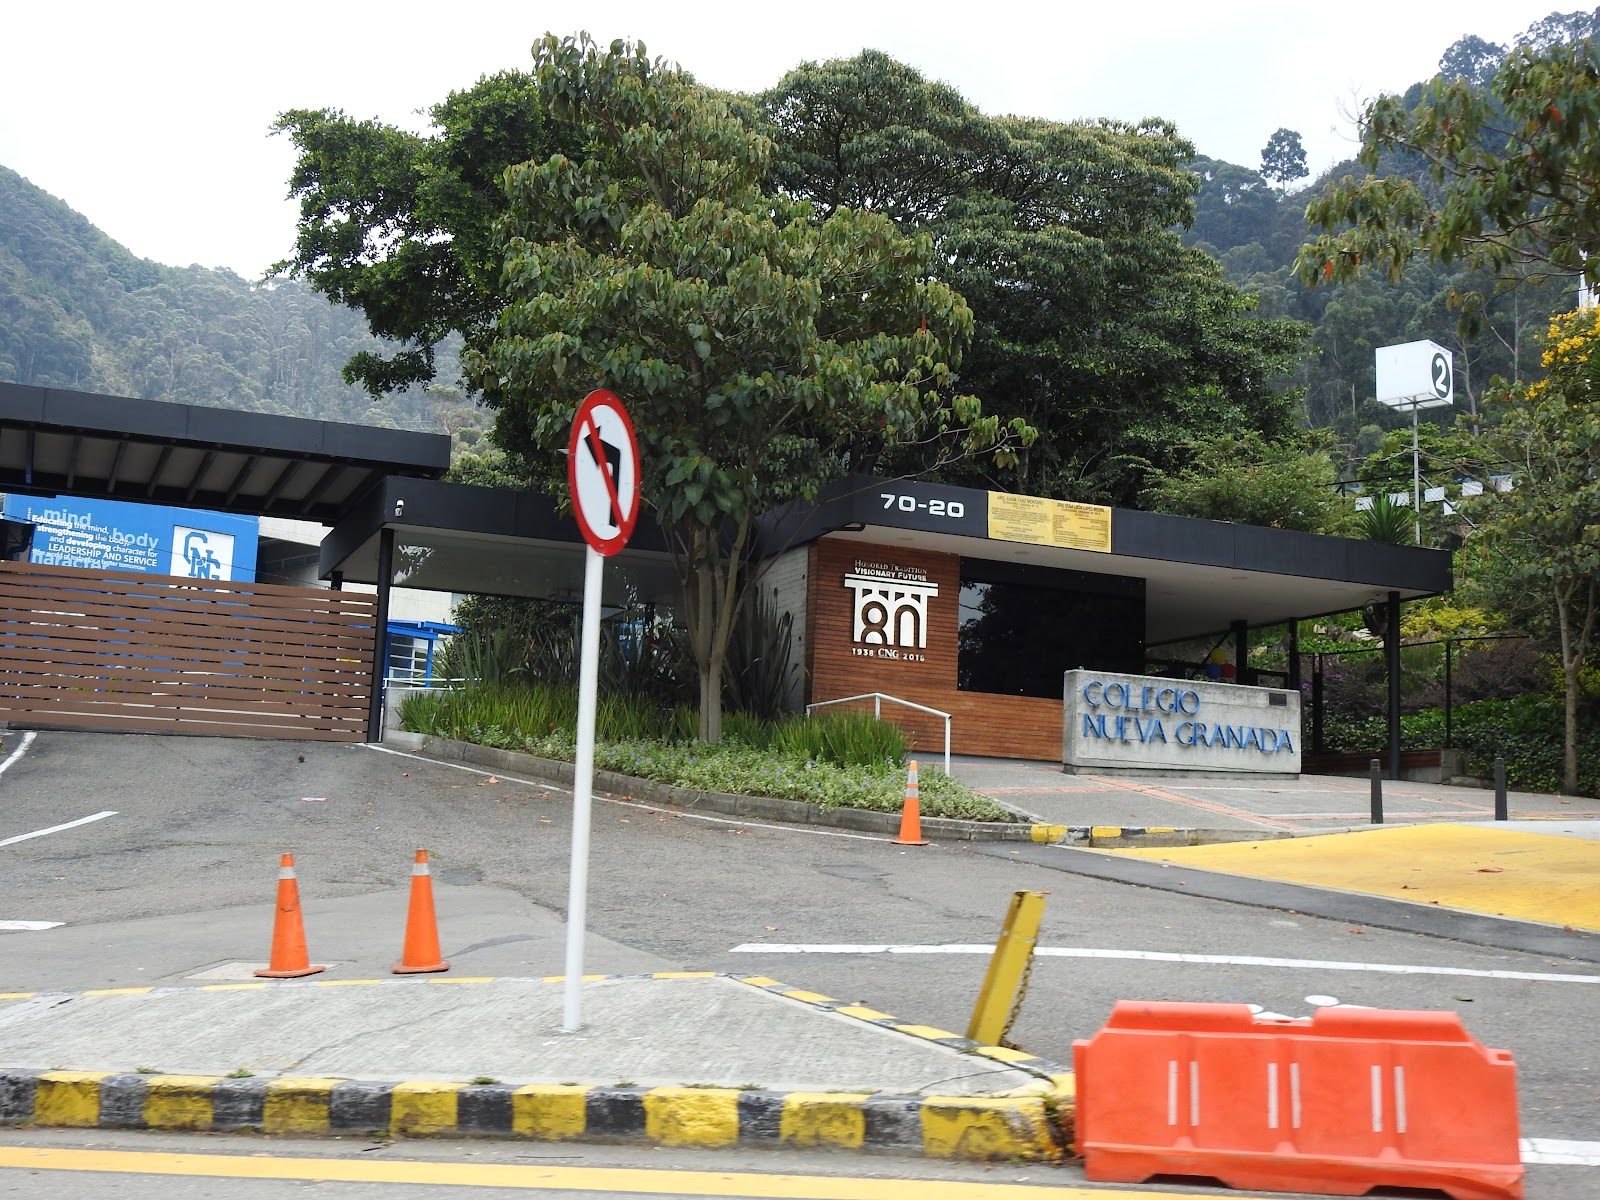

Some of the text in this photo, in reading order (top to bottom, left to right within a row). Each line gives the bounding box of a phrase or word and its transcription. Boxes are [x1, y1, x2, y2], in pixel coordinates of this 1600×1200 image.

[1436, 357, 1447, 393] 2
[880, 493, 965, 518] 70-20
[32, 514, 72, 529] Educating
[74, 521, 87, 530] the
[44, 508, 92, 526] mind
[37, 525, 94, 541] strengthening
[95, 533, 108, 542] the
[113, 528, 159, 549] body
[48, 543, 158, 567] LEADERSHIP AND SERVICE
[49, 536, 158, 558] and developing character for
[852, 648, 874, 657] 1938
[877, 648, 899, 660] CNG
[1083, 681, 1200, 715] COLEGIO
[1083, 713, 1295, 754] NUEVA GRANADA
